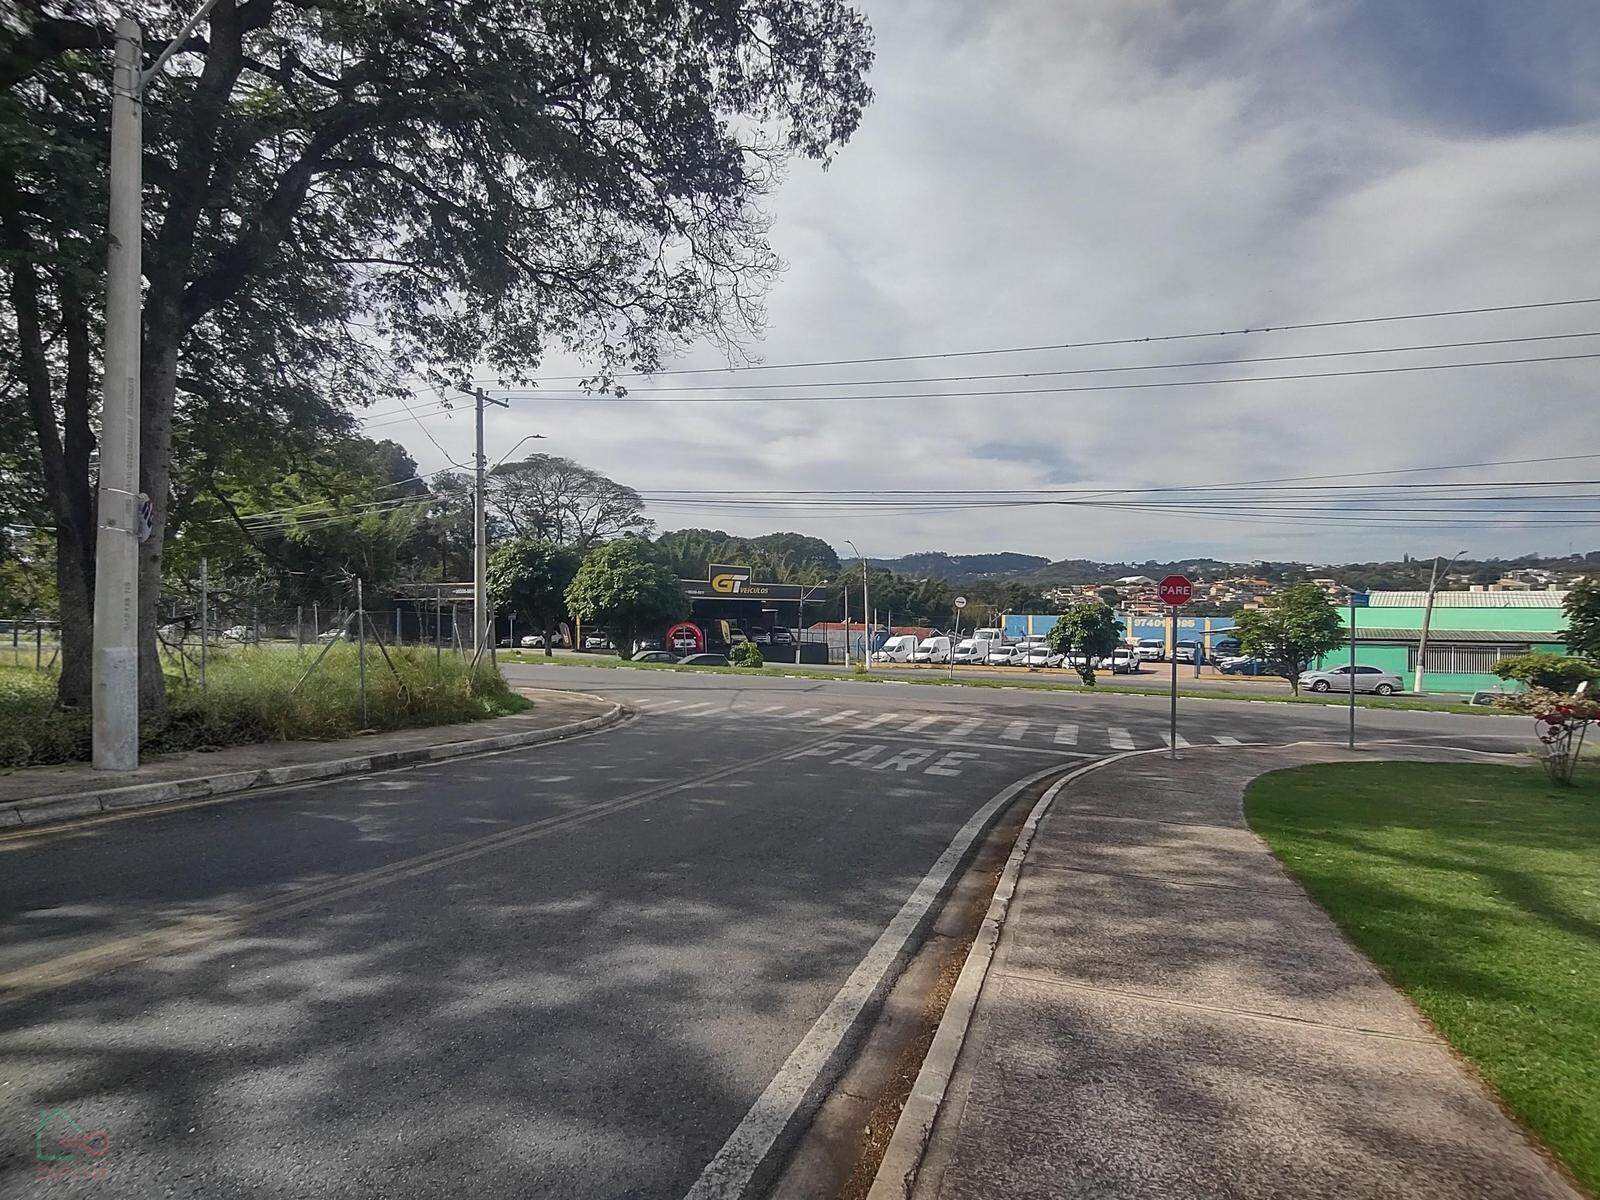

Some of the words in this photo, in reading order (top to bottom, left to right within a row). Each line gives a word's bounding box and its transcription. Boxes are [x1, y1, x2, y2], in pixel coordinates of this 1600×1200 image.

[712, 574, 749, 593] GT
[1160, 585, 1190, 595] PARE
[783, 741, 981, 777] PARE
